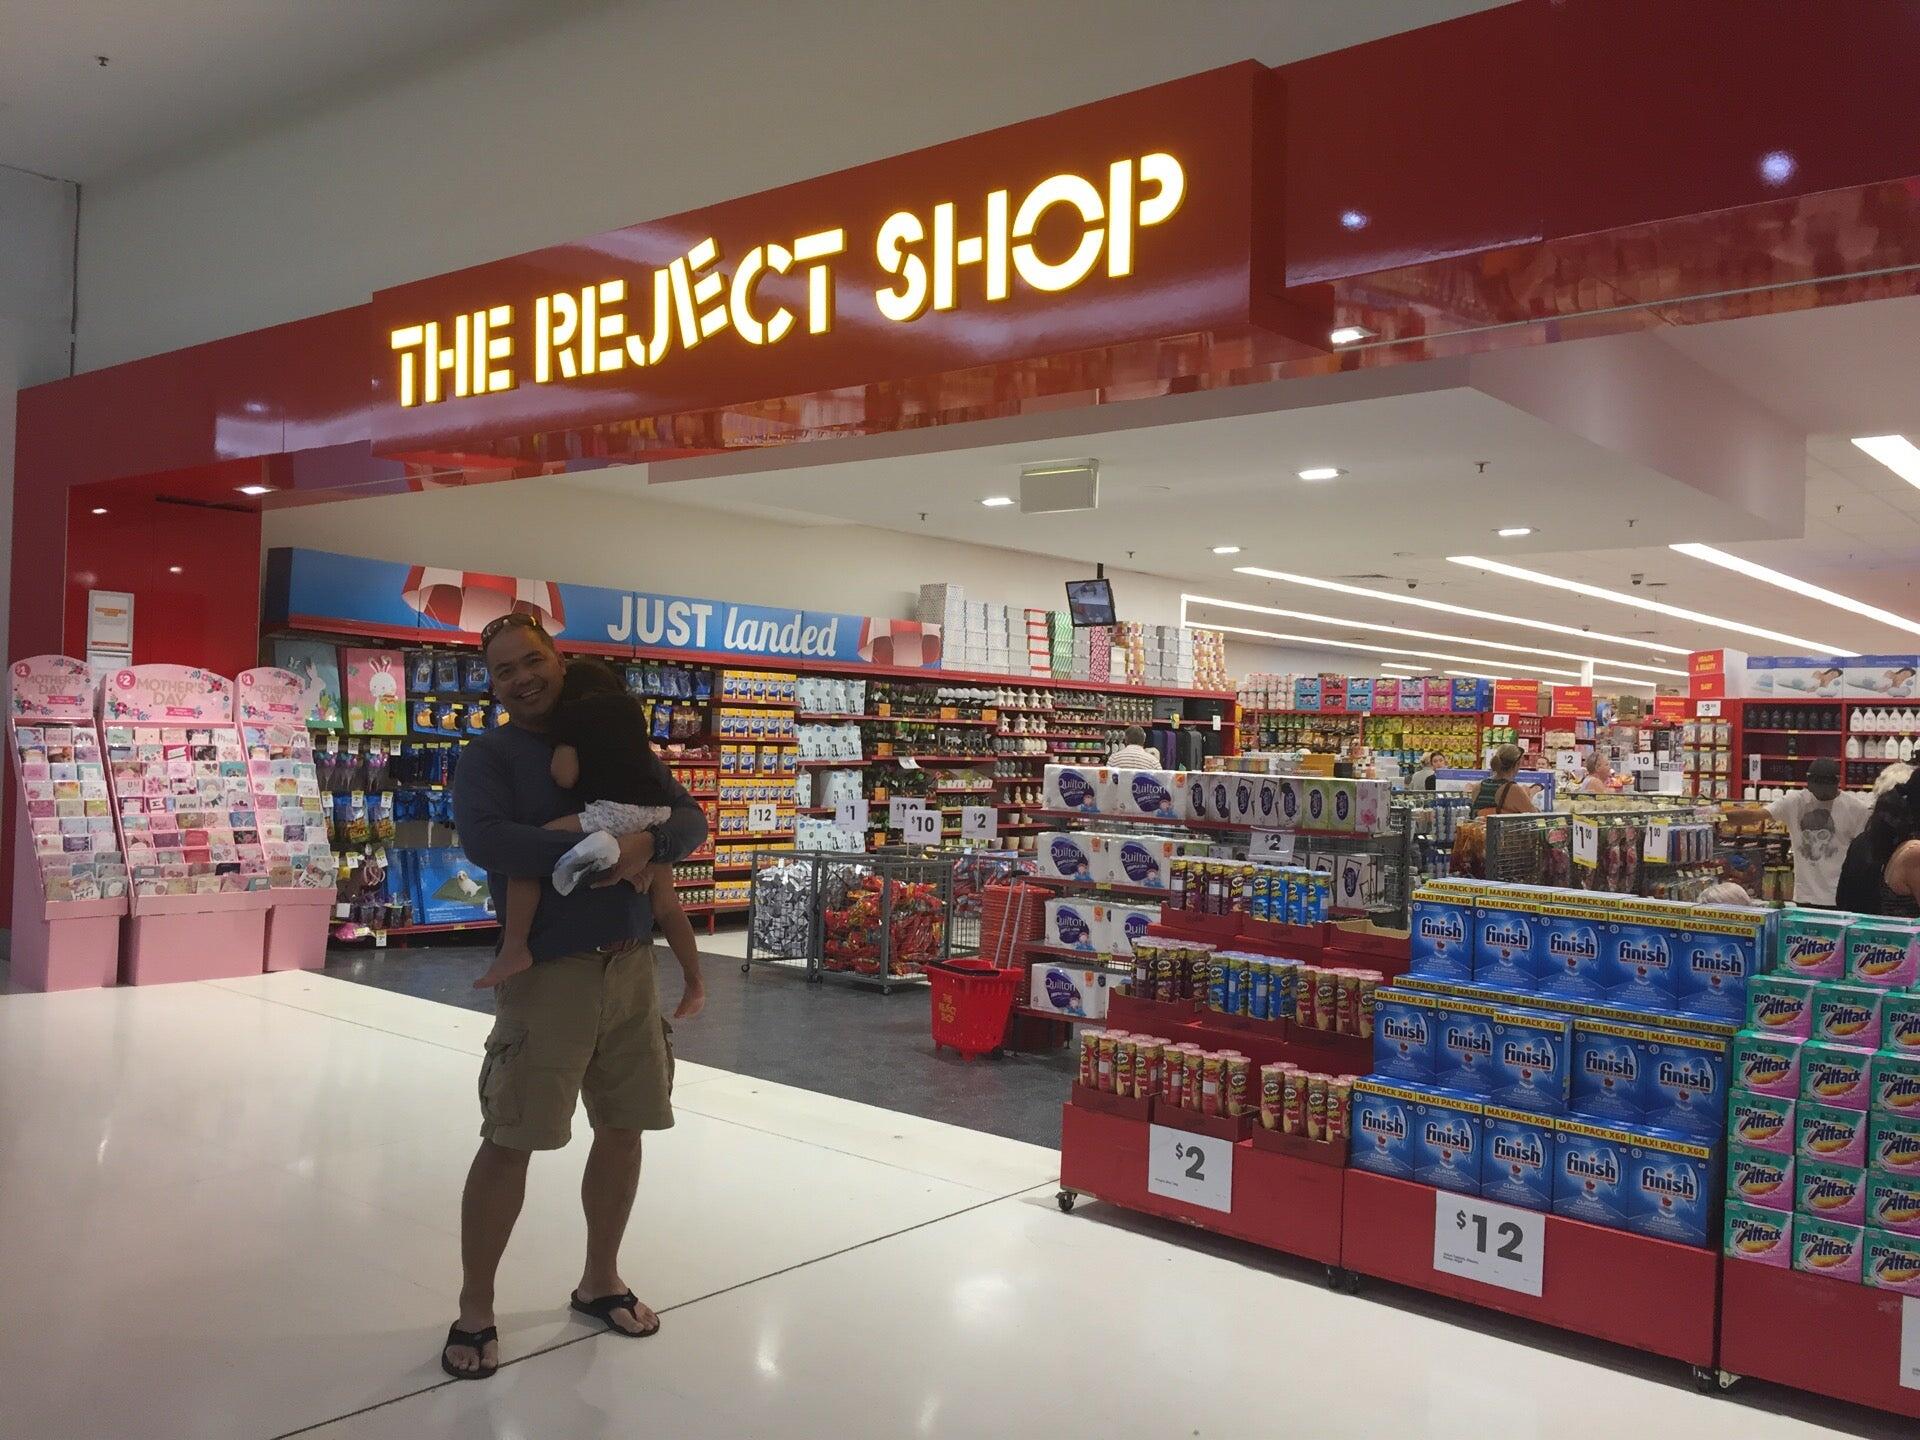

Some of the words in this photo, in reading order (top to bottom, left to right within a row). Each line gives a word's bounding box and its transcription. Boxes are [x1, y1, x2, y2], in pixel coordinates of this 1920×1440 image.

[391, 305, 515, 408] THE
[535, 236, 845, 384] REJECT
[875, 152, 1187, 325] SHOP
[607, 596, 712, 647] JUST
[723, 607, 838, 657] landed
[119, 672, 132, 686] $2
[136, 678, 205, 694] MOTHER'S
[39, 685, 64, 695] DAY
[153, 692, 186, 706] DAY
[1060, 780, 1090, 790] Quilton
[1132, 783, 1166, 794] Quilton
[754, 808, 772, 822] $12
[845, 805, 856, 820] $1
[911, 816, 934, 833] $10
[973, 813, 986, 829] $2
[1264, 834, 1282, 851] $2
[1051, 848, 1083, 858] Quilton
[1120, 851, 1154, 863] Quilton
[1428, 882, 1448, 890] MAXI
[1451, 885, 1468, 893] PACK
[1469, 886, 1484, 894] X60
[1511, 891, 1532, 899] PACK
[1533, 892, 1548, 900] X60
[1415, 892, 1434, 900] MAXI
[1435, 895, 1454, 903] PACK
[1456, 896, 1470, 904] X60
[1478, 899, 1499, 907] MAXI
[1501, 902, 1520, 910] PACK
[1553, 895, 1574, 903] MAXI
[1577, 897, 1599, 905] PACK
[1601, 900, 1616, 908] X60
[1542, 906, 1565, 914] MAXI
[1567, 909, 1586, 917] PACK
[1590, 912, 1605, 920] X60
[1622, 902, 1643, 910] MAXI
[1670, 907, 1687, 915] X60
[1693, 910, 1717, 918] MAXI
[1719, 912, 1741, 920] PACK
[1743, 914, 1761, 923] X60
[1057, 917, 1085, 927] Quilton
[1125, 922, 1148, 934] Quilt
[1421, 917, 1462, 938] finish
[1611, 913, 1633, 921] MAXI
[1636, 916, 1658, 924] PACK
[1660, 919, 1677, 927] X60
[1485, 925, 1528, 946] finish
[1683, 922, 1705, 930] MAXI
[1708, 925, 1732, 933] PACK
[1735, 927, 1751, 935] X60
[1550, 932, 1595, 955] finish
[1786, 935, 1803, 944] BIO
[1619, 940, 1667, 964] finish
[1791, 940, 1836, 959] Attack
[1854, 944, 1872, 953] BIO
[1692, 950, 1742, 973] finish
[1859, 948, 1905, 967] Attack
[1377, 992, 1398, 1000] MAXI
[1398, 995, 1416, 1003] PACK
[1418, 997, 1433, 1006] X60
[1440, 1000, 1461, 1009] MAXI
[1462, 1004, 1483, 1012] PACK
[1754, 994, 1771, 1004] BIO
[1759, 1000, 1803, 1017] Attack
[1820, 1003, 1838, 1013] BIO
[1496, 1014, 1520, 1023] MAXI
[1522, 1017, 1543, 1026] PACK
[1544, 1021, 1561, 1030] X60
[1826, 1009, 1872, 1028] Attack
[1890, 1013, 1908, 1022] BIO
[1384, 1018, 1425, 1040] finish
[1577, 1022, 1600, 1031] MAXI
[1603, 1026, 1625, 1035] PACK
[1627, 1029, 1644, 1038] X60
[1448, 1029, 1491, 1050] finish
[1652, 1034, 1676, 1043] MAXI
[1678, 1037, 1701, 1046] PACK
[1704, 1041, 1722, 1049] X60
[1504, 1043, 1551, 1066] finish
[1740, 1052, 1757, 1062] BIO
[1585, 1051, 1634, 1076] finish
[1746, 1058, 1791, 1076] Attack
[1808, 1063, 1825, 1072] BIO
[1659, 1063, 1710, 1089] finish
[1814, 1069, 1861, 1087] Attack
[1879, 1073, 1897, 1082] BIO
[1355, 1083, 1377, 1091] MAXI
[1377, 1086, 1397, 1095] PACK
[1398, 1089, 1413, 1099] X60
[1419, 1096, 1440, 1105] MAXI
[1442, 1099, 1462, 1109] PACK
[1463, 1103, 1479, 1112] X60
[1735, 1107, 1752, 1117] BIO
[1362, 1109, 1403, 1134] finish
[1487, 1108, 1509, 1117] MAXI
[1511, 1112, 1533, 1121] PACK
[1534, 1116, 1551, 1125] X60
[1740, 1113, 1784, 1131] Attack
[1803, 1119, 1820, 1129] BIO
[1426, 1123, 1469, 1148] finish
[1558, 1122, 1582, 1132] MAXI
[1584, 1126, 1606, 1137] PACK
[1608, 1131, 1626, 1141] X60
[1809, 1125, 1855, 1143] Attack
[1878, 1131, 1896, 1140] BIO
[1494, 1136, 1540, 1163] finish
[1634, 1137, 1658, 1146] MAXI
[1661, 1140, 1685, 1151] PACK
[1687, 1146, 1705, 1157] X60
[1175, 1142, 1206, 1181] $2
[1567, 1151, 1616, 1179] finish
[1735, 1162, 1751, 1171] BIO
[1642, 1167, 1694, 1195] finish
[1739, 1168, 1784, 1186] Attack
[1804, 1175, 1821, 1185] BIO
[1809, 1181, 1856, 1199] Attack
[1875, 1188, 1893, 1197] BIO
[1880, 1194, 1920, 1212] Attac
[1731, 1219, 1748, 1229] BIO
[1456, 1210, 1523, 1263] $12
[1736, 1225, 1781, 1243] Attack
[1801, 1233, 1818, 1243] BIO
[1806, 1240, 1853, 1257] Attack
[1871, 1247, 1889, 1256] BIO
[1877, 1254, 1920, 1272] Attac
